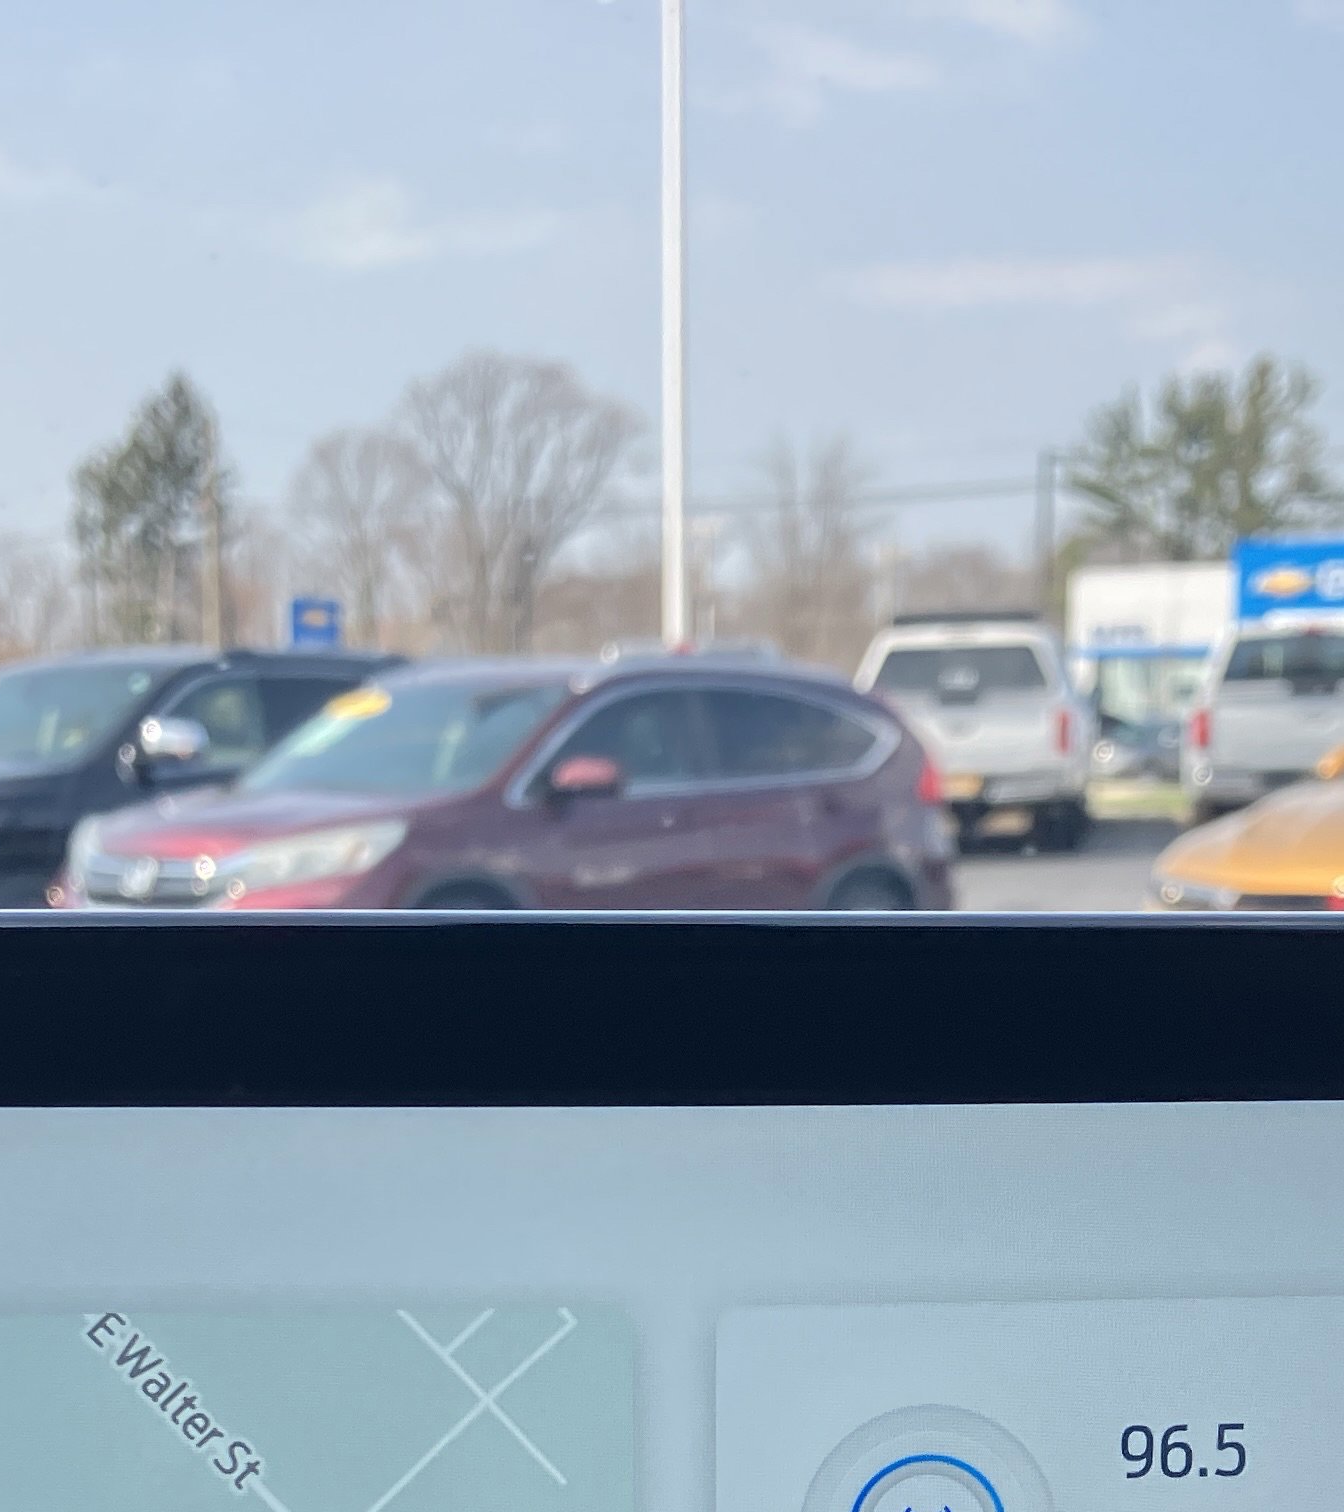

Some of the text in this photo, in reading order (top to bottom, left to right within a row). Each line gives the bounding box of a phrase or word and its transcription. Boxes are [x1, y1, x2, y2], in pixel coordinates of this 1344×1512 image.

[86, 1311, 261, 1490] E Walter St
[1121, 1423, 1246, 1479] 96.5
